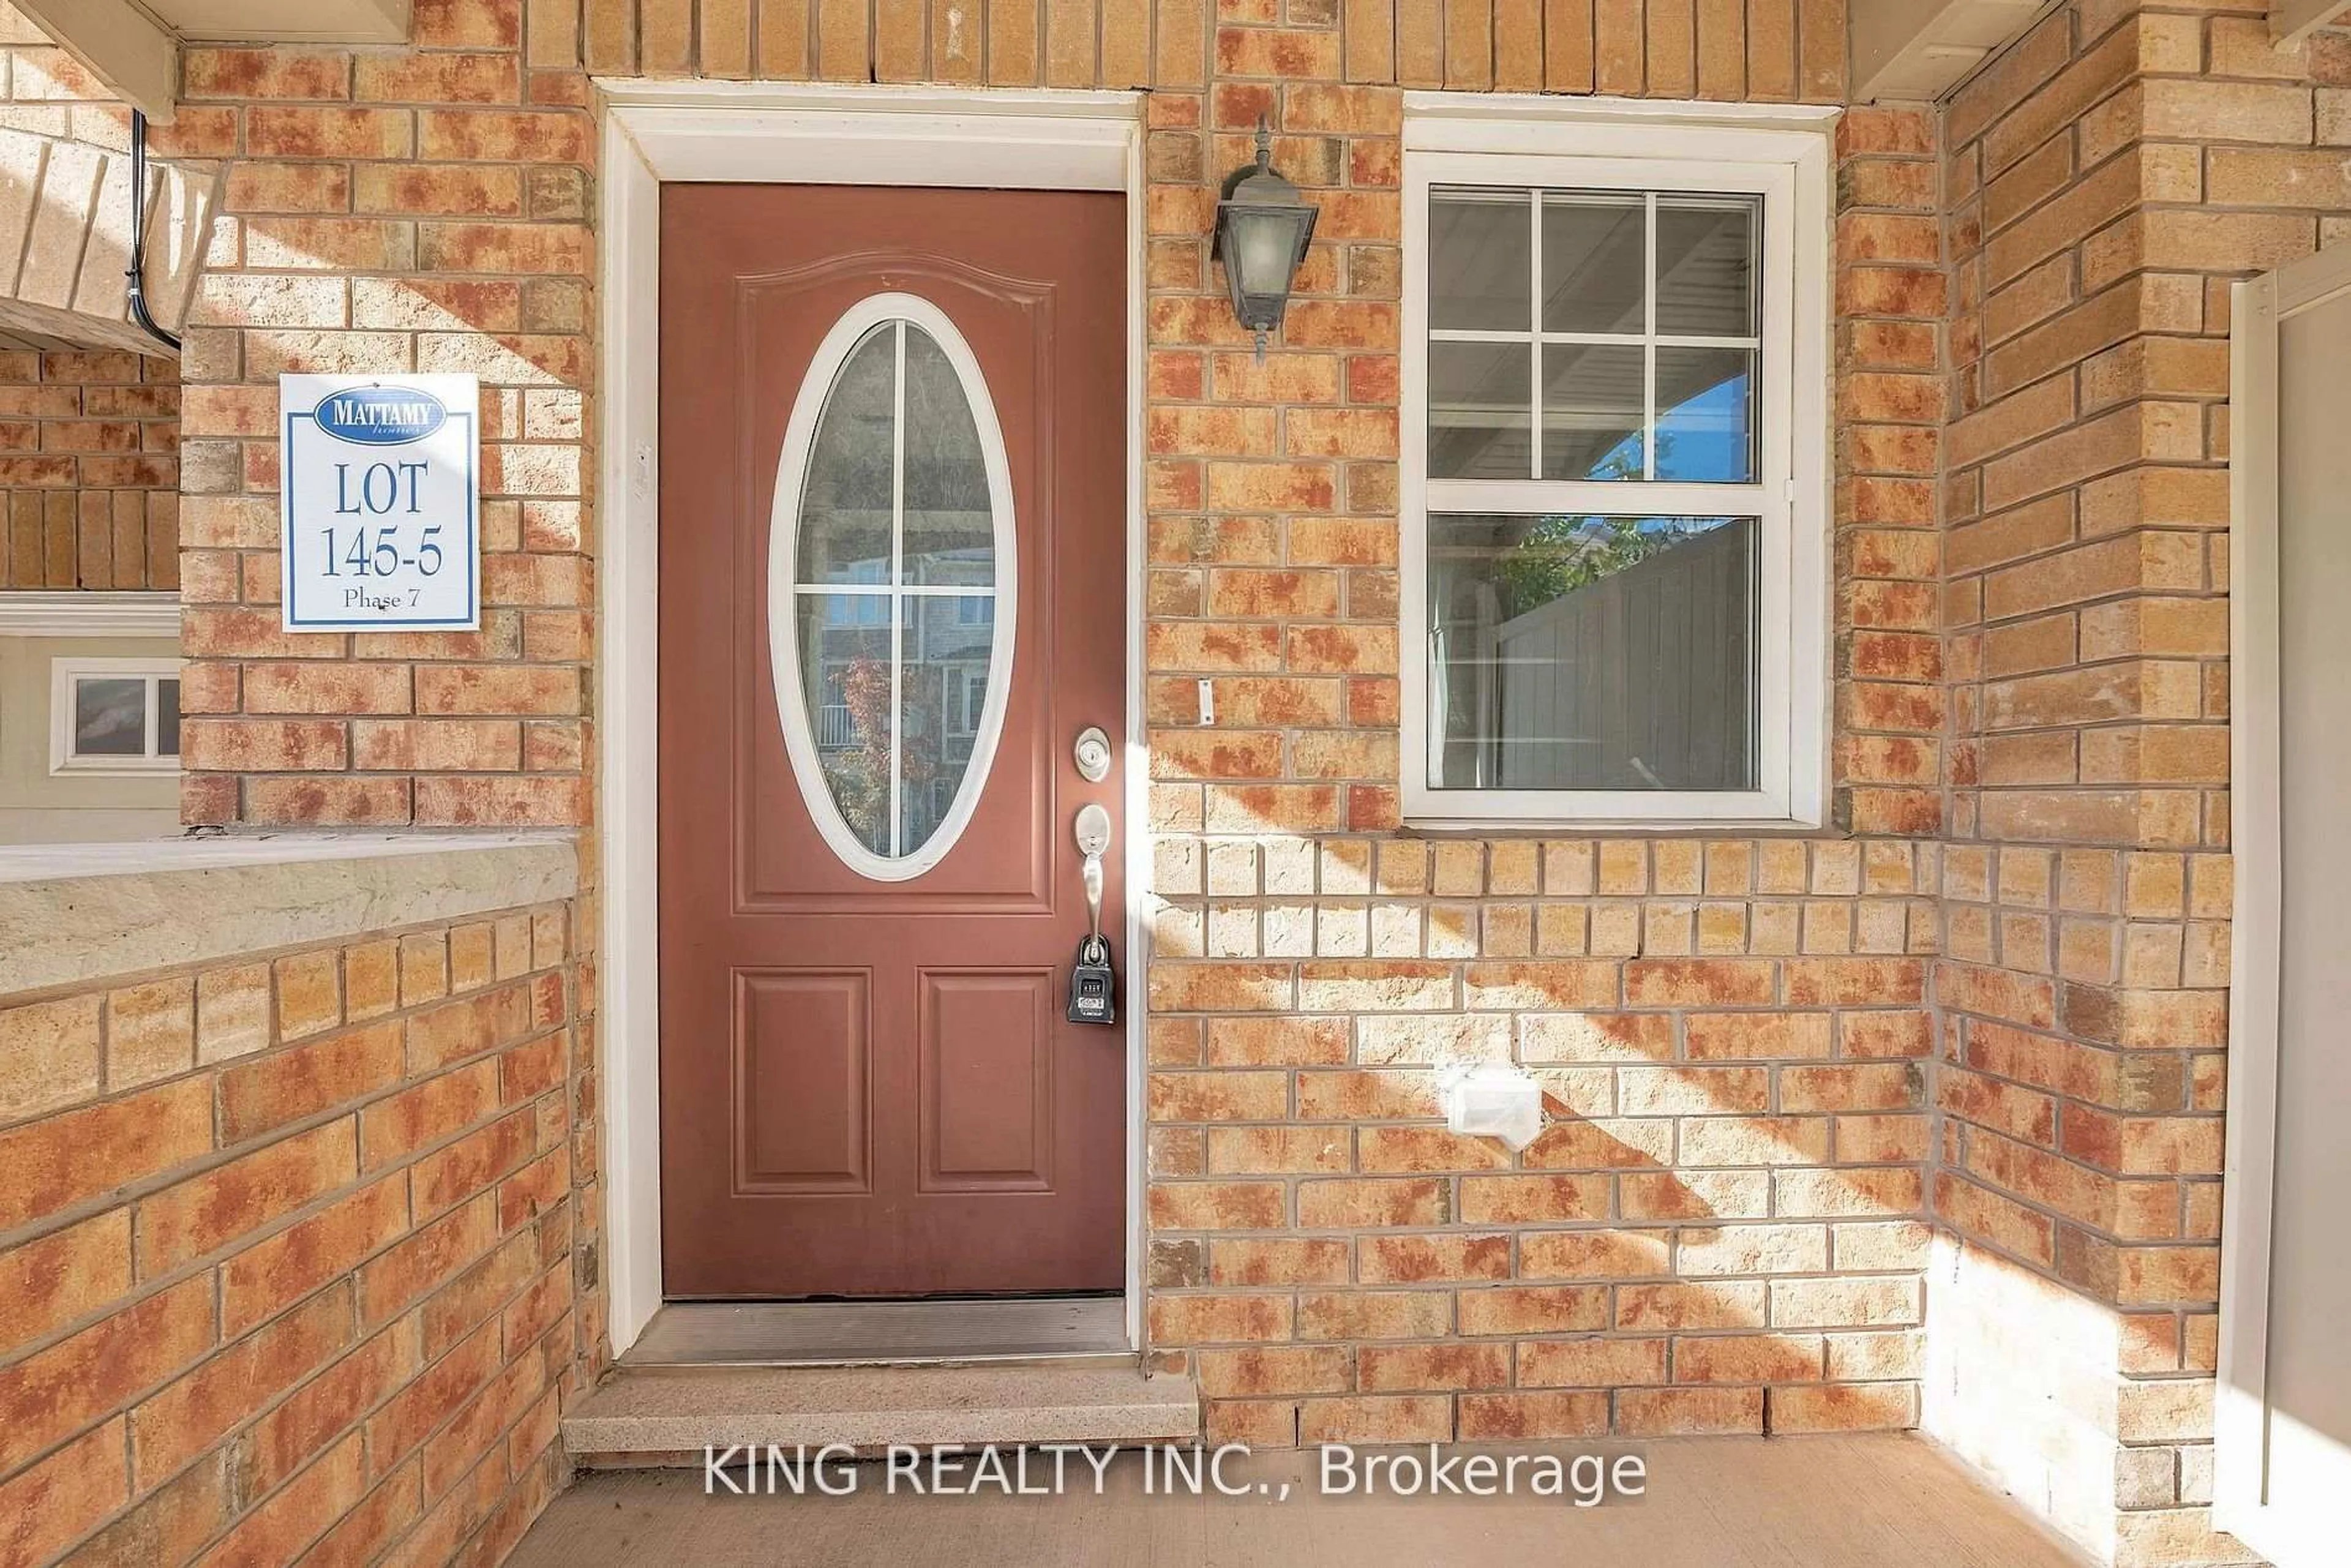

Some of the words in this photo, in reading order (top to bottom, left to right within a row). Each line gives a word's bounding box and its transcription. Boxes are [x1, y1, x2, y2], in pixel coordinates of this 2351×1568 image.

[332, 399, 432, 426] MATTAMY
[334, 459, 428, 515] LOT
[320, 524, 442, 577] 145-5
[344, 586, 402, 608] Phase
[408, 588, 421, 607] 7
